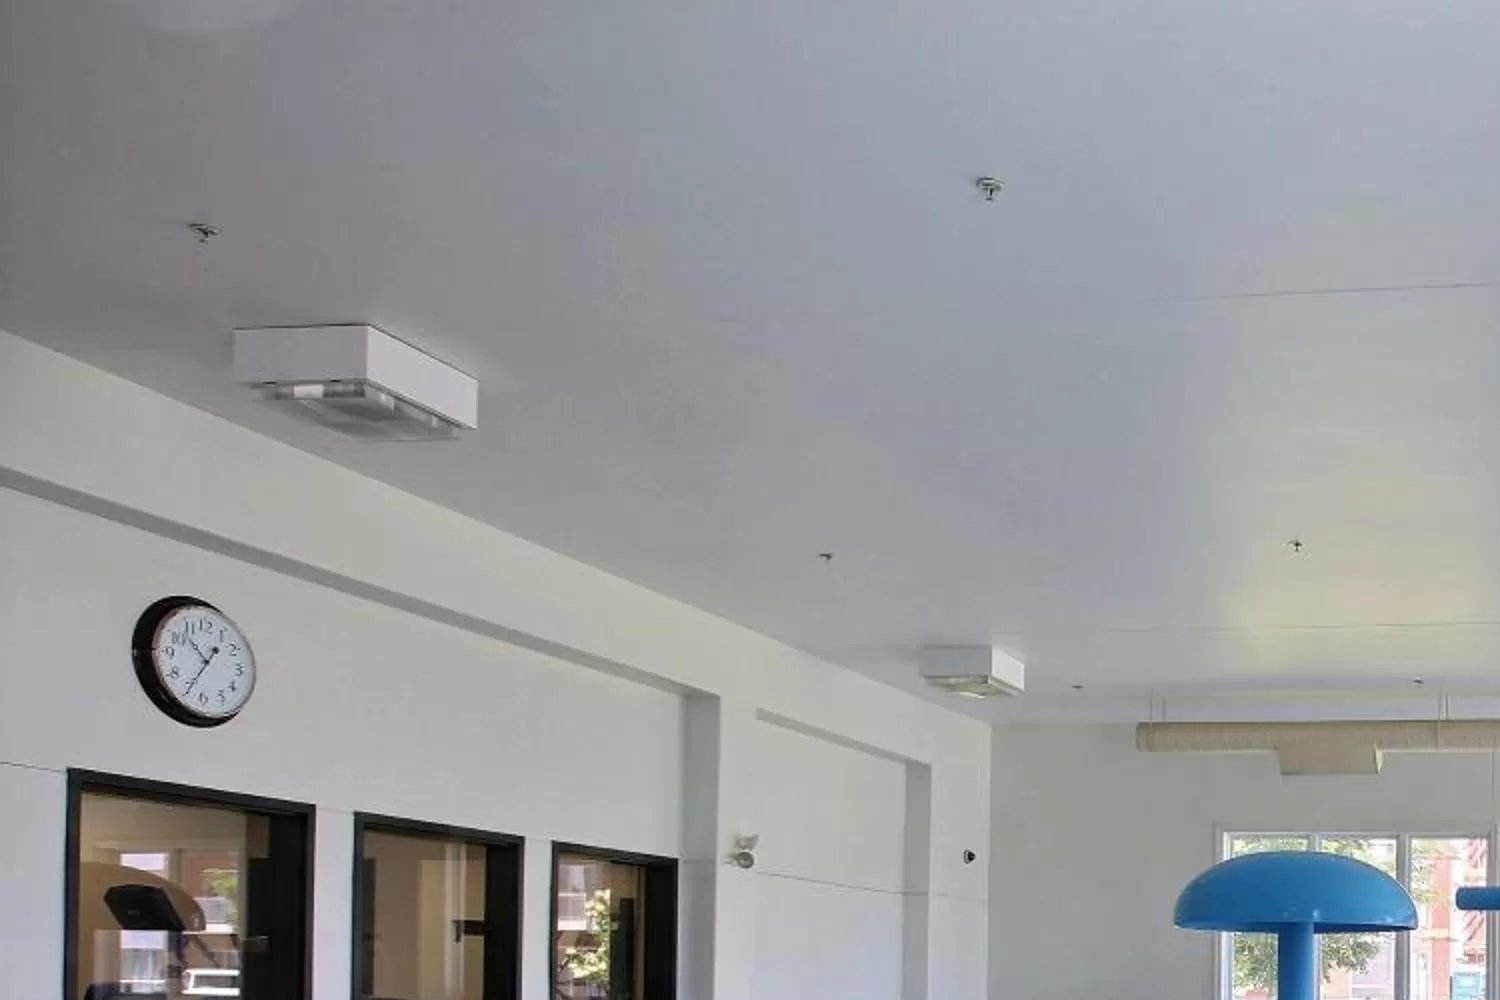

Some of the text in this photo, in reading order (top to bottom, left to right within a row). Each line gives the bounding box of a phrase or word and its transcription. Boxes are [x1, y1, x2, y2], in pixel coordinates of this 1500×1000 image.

[185, 620, 196, 635] 11
[198, 618, 213, 634] 12
[171, 631, 187, 647] 10
[219, 629, 225, 643] 1
[165, 646, 175, 660] 9
[229, 643, 237, 657] 2
[171, 666, 179, 680] 8
[235, 663, 244, 677] 3
[199, 692, 209, 705] 6
[217, 690, 226, 706] 5
